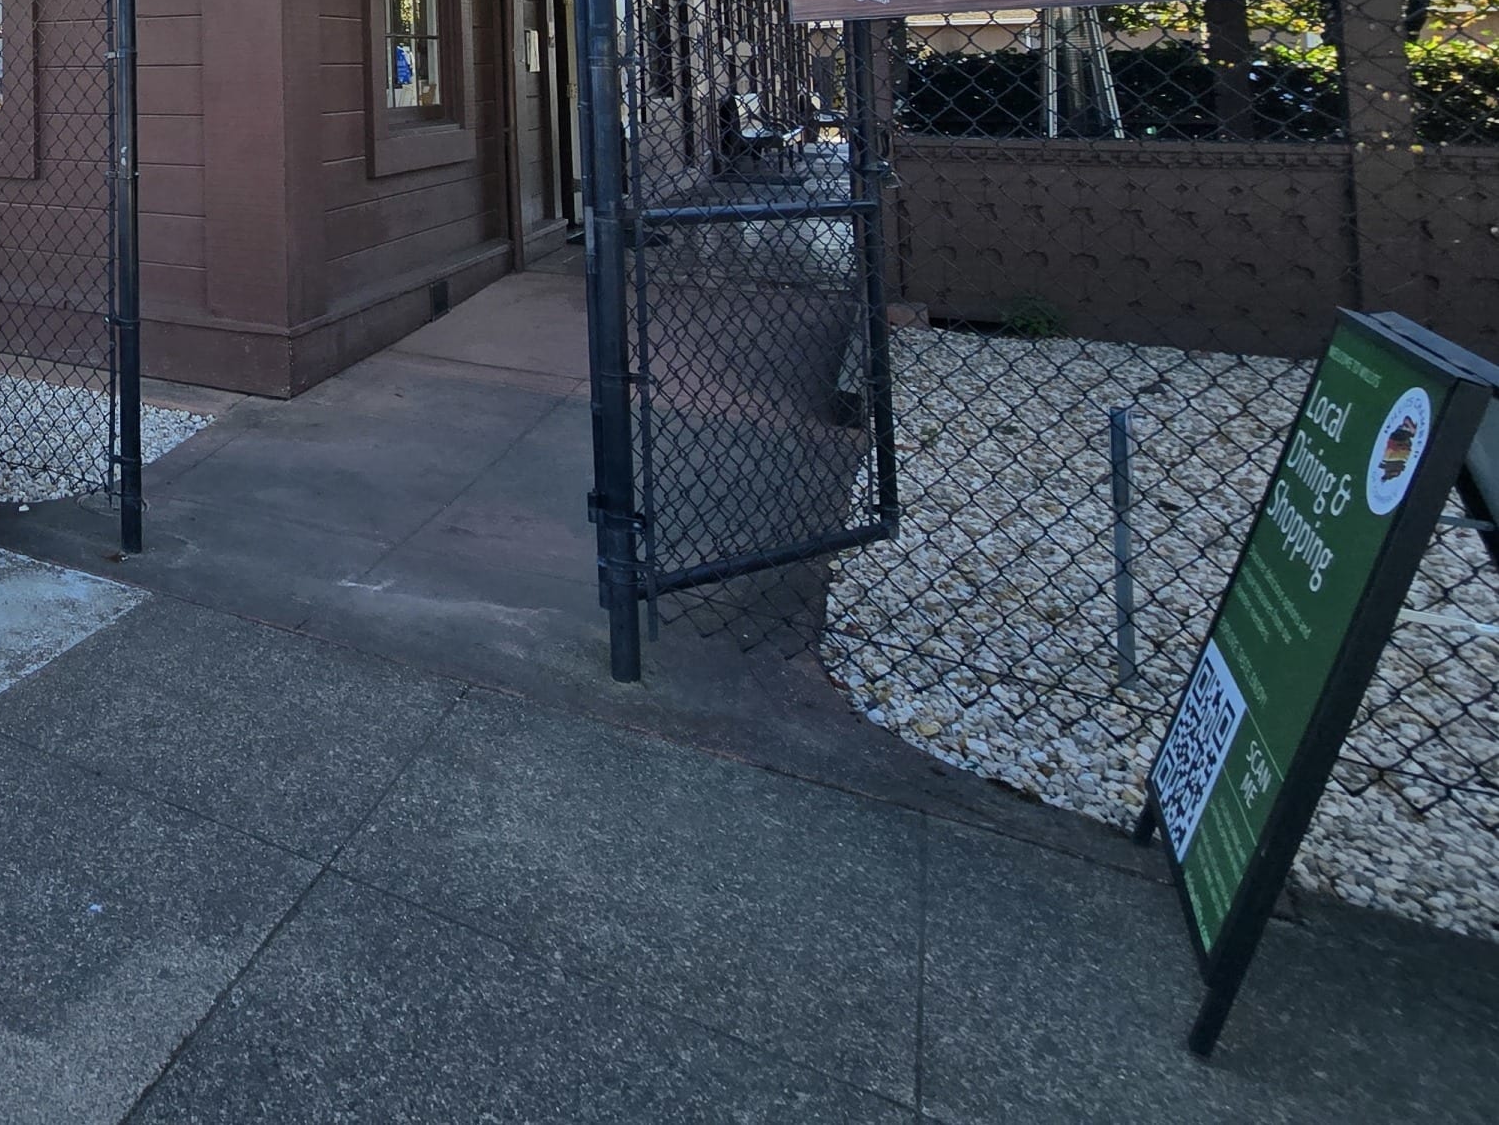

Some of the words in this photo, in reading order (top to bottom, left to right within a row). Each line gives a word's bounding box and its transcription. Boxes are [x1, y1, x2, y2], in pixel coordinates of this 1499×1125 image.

[1305, 380, 1353, 443] Local
[1286, 429, 1337, 515] Dining
[1330, 473, 1352, 517] &
[1266, 479, 1334, 592] Shopping
[1240, 772, 1258, 809] ME
[1246, 740, 1272, 793] SCAN
